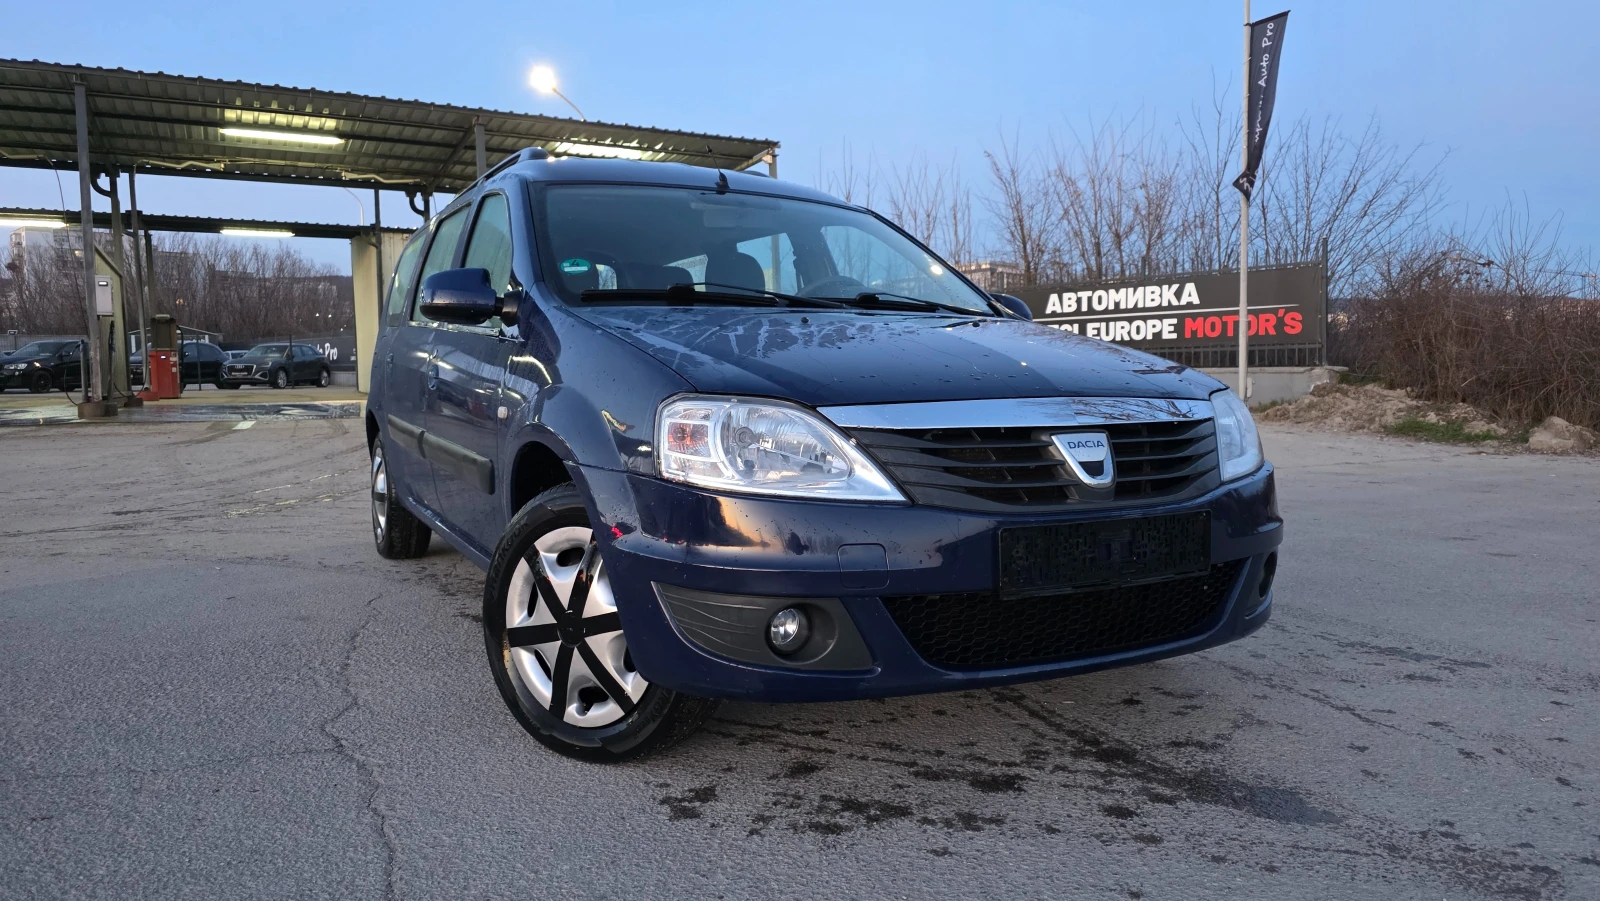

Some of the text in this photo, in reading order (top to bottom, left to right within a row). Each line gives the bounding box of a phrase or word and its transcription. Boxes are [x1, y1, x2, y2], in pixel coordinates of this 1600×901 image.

[1262, 22, 1275, 48] Pro
[1257, 53, 1270, 88] Auto
[1045, 282, 1200, 315] АВТОМИВКА
[1086, 318, 1178, 342] EUROPE
[1184, 308, 1303, 339] MOTOR'S
[1067, 440, 1105, 449] DACIA
